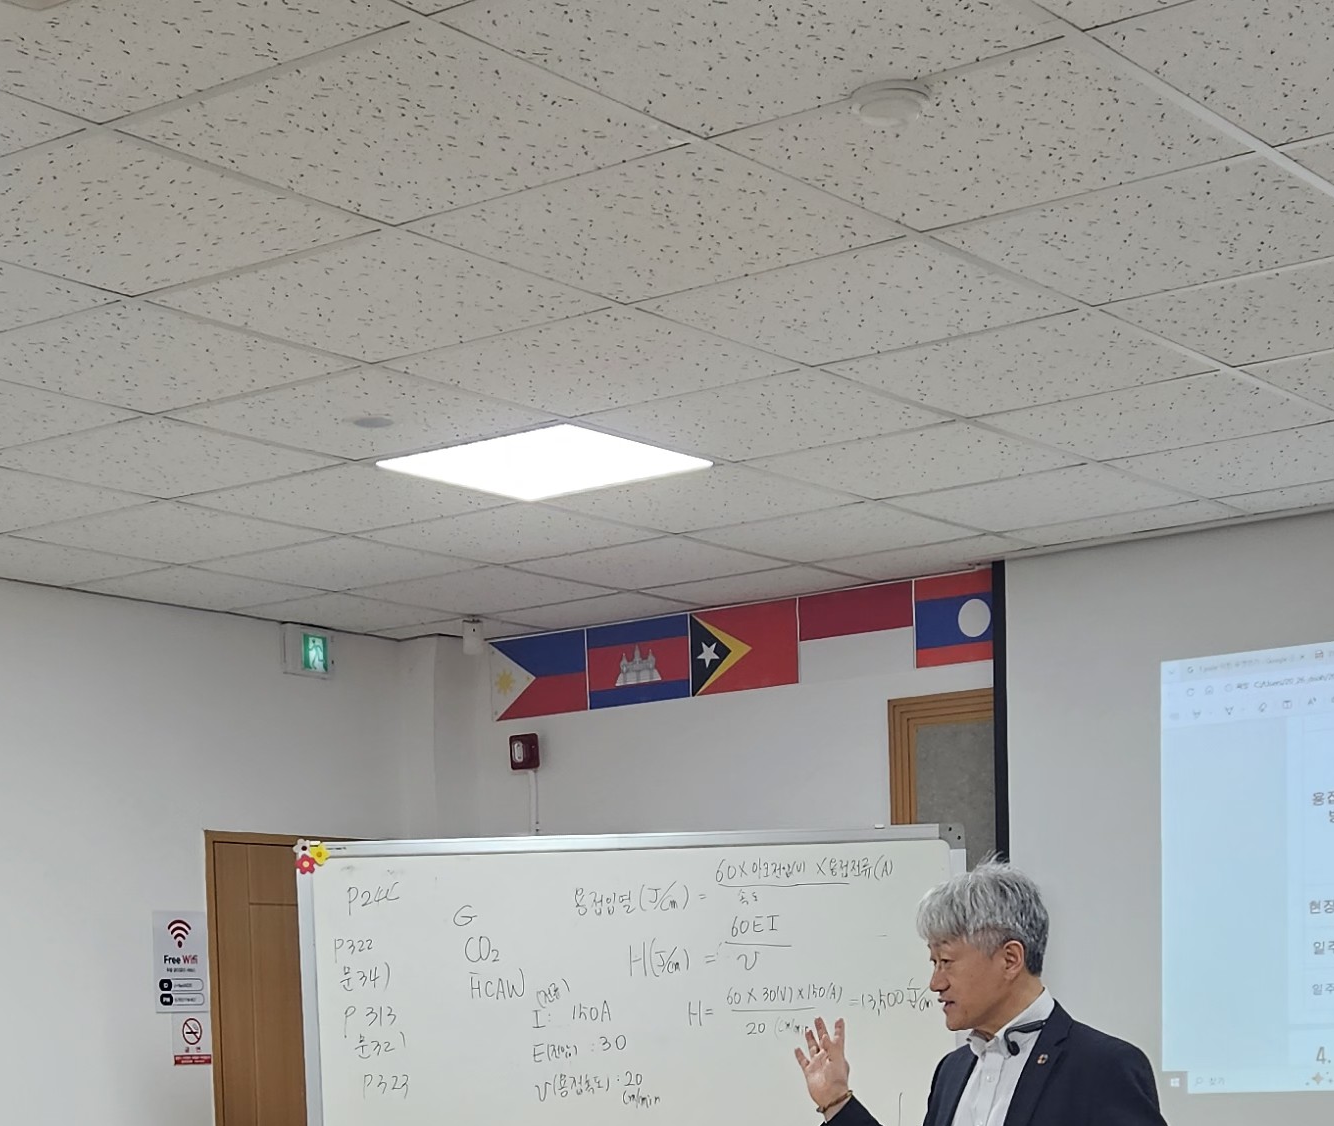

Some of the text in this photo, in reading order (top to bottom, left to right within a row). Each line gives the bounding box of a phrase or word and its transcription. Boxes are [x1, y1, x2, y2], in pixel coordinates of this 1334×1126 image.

[452, 904, 479, 927] G
[163, 954, 198, 965] Free Wifi
[1315, 1045, 1332, 1065] 4.
